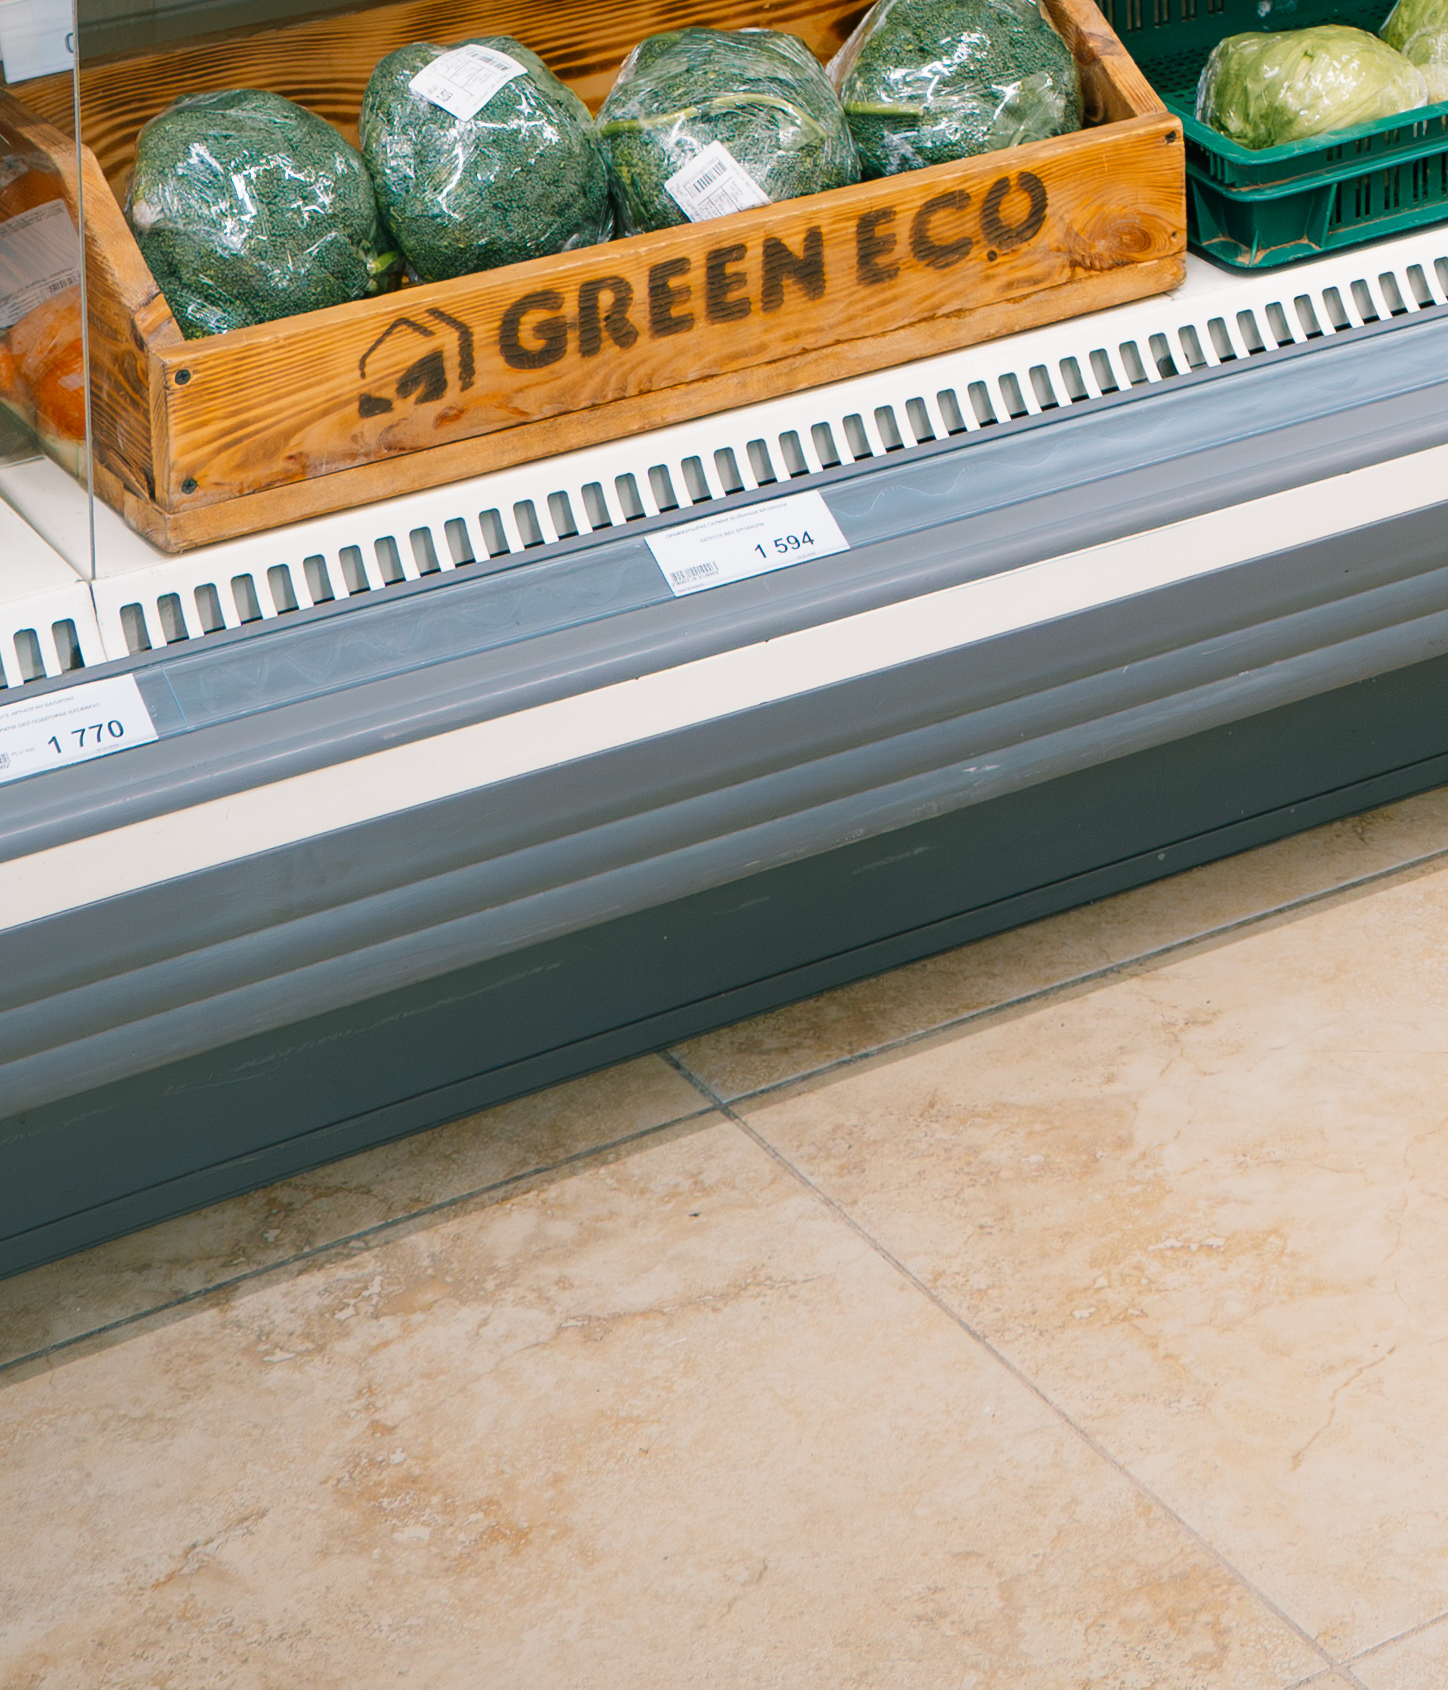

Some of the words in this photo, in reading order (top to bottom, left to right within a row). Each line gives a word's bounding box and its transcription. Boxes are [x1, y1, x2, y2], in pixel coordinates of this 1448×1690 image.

[499, 224, 827, 370] GREEN
[856, 170, 1049, 287] ECO
[754, 543, 767, 559] 1
[773, 530, 815, 554] 594
[48, 735, 62, 754] 1
[71, 719, 124, 748] 770
